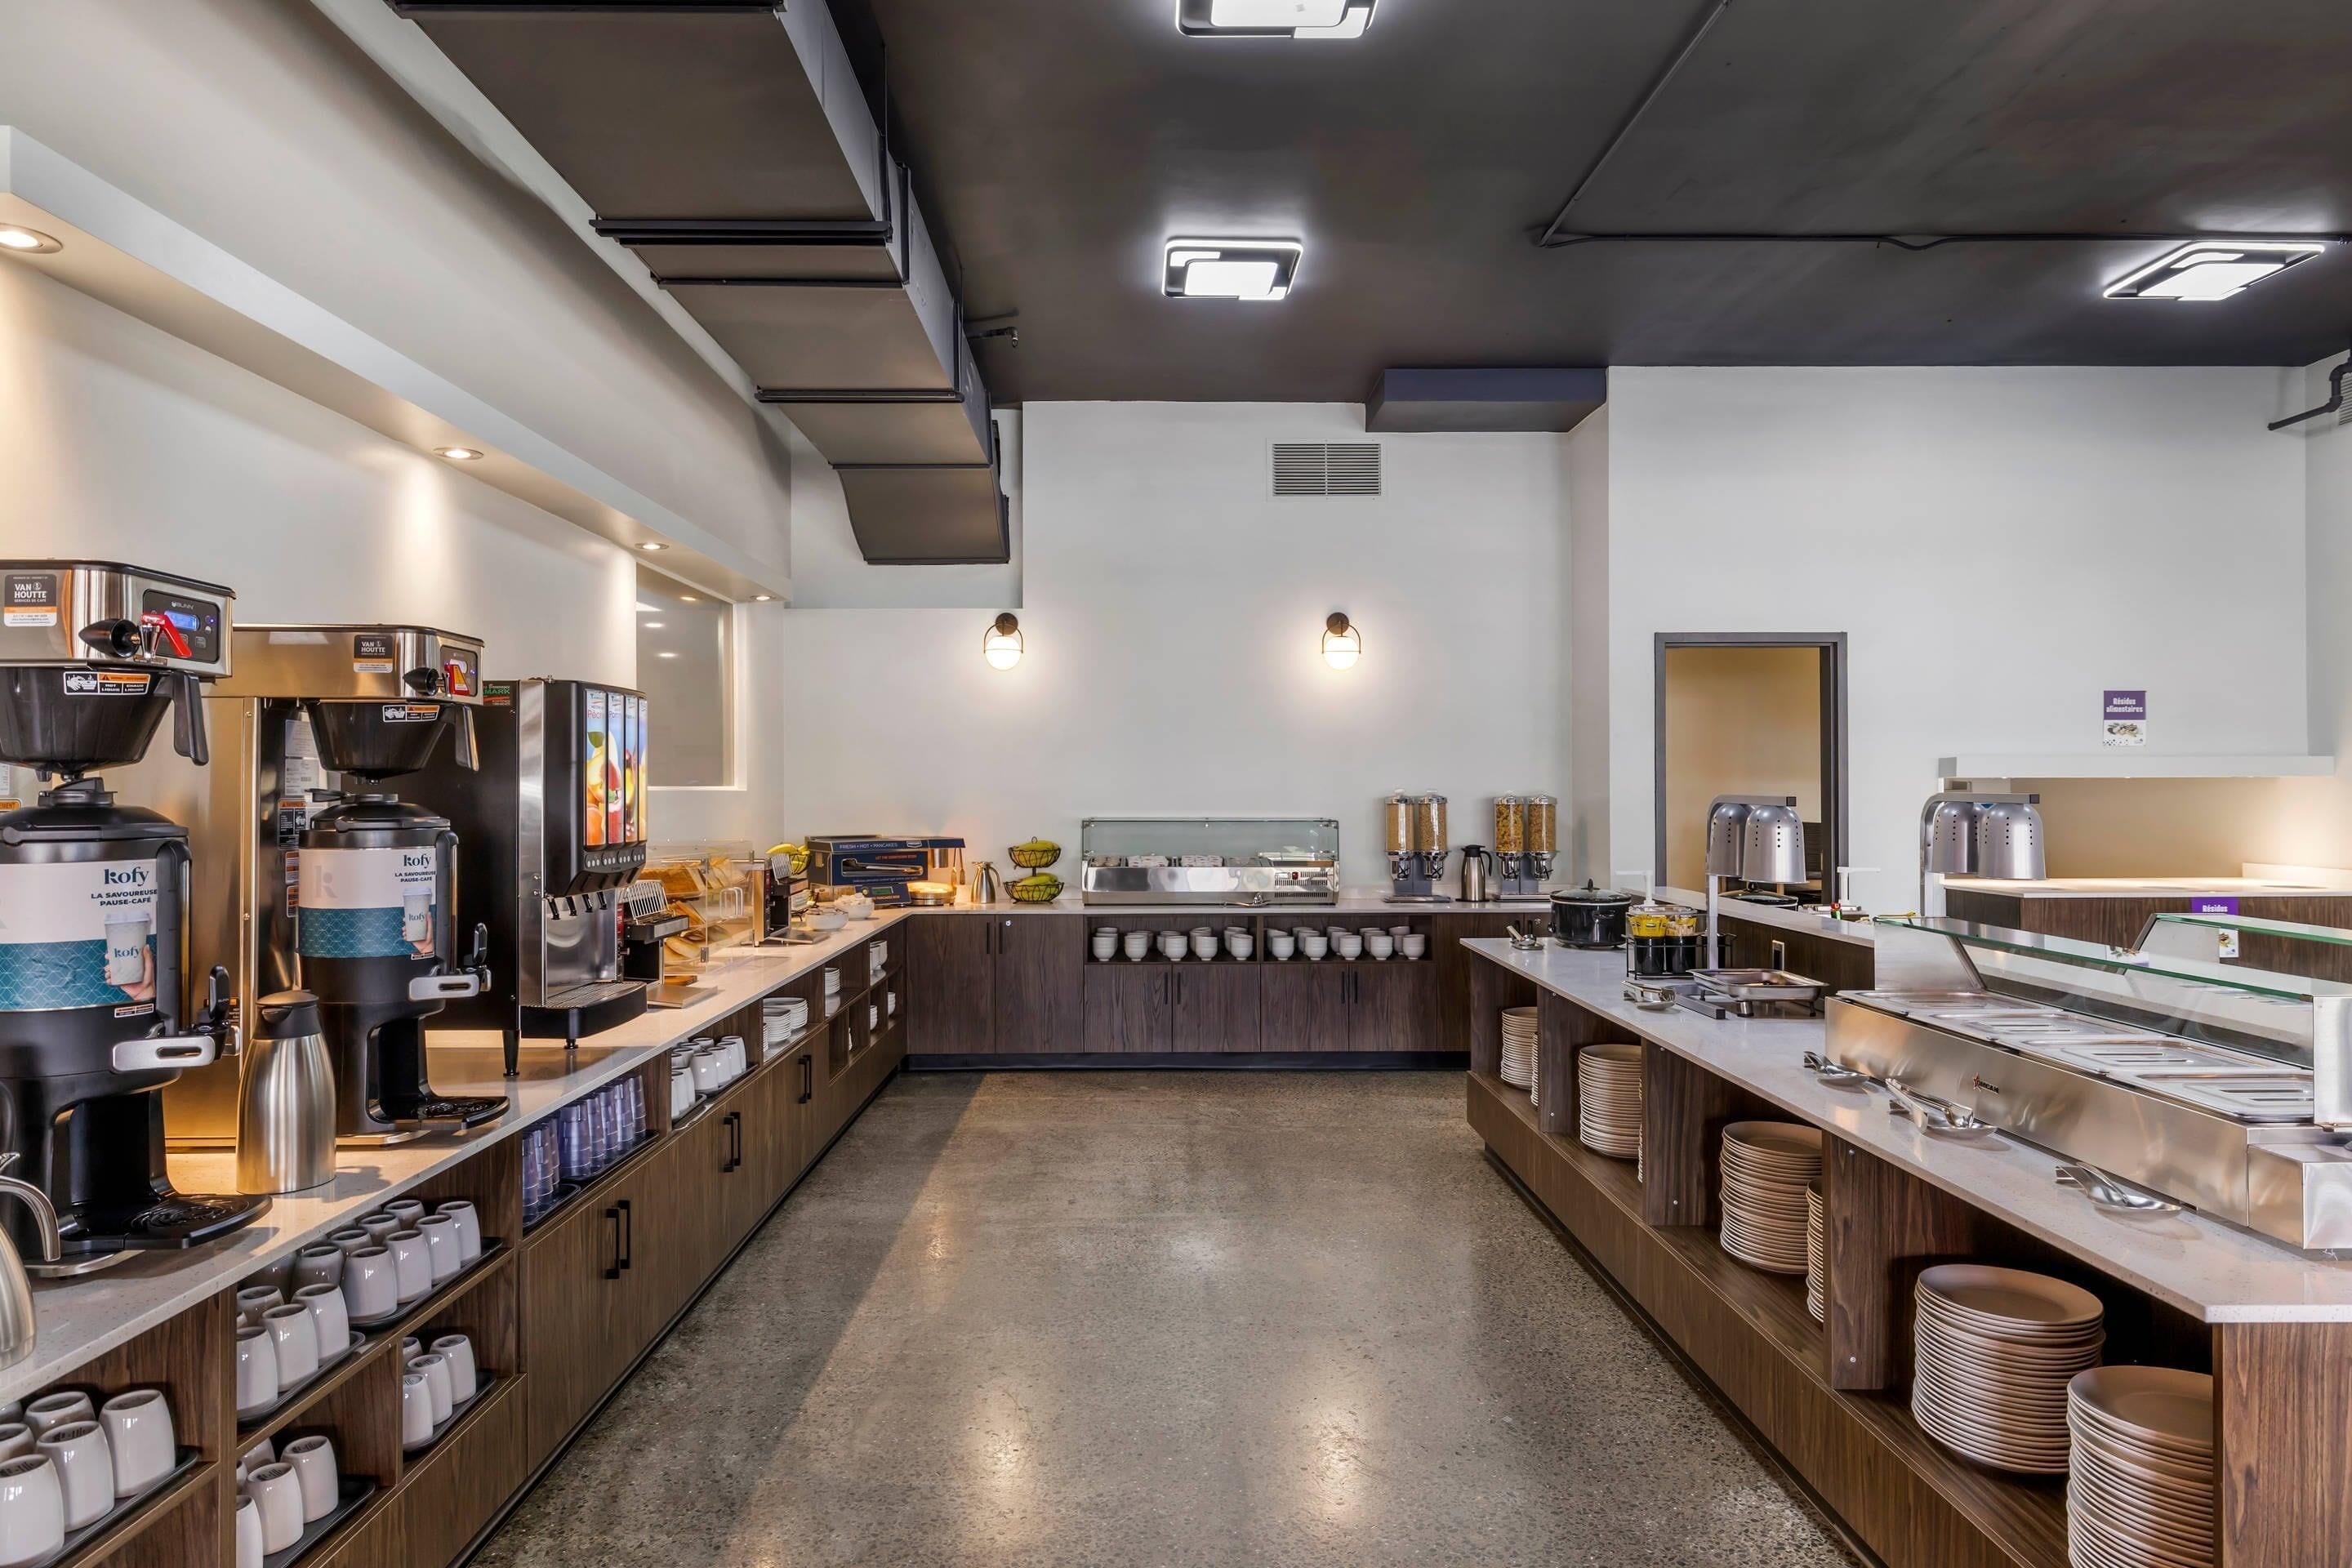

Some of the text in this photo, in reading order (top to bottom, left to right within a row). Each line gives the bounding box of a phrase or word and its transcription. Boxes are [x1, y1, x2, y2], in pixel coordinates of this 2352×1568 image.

[14, 583, 32, 591] VAN
[14, 590, 47, 599] HOUTTE
[2105, 705, 2144, 713] alimentaires
[105, 889, 158, 898] SAVOUREUSE
[100, 896, 151, 906] PAUSE-CAFÉ
[2202, 904, 2228, 912] Résidus
